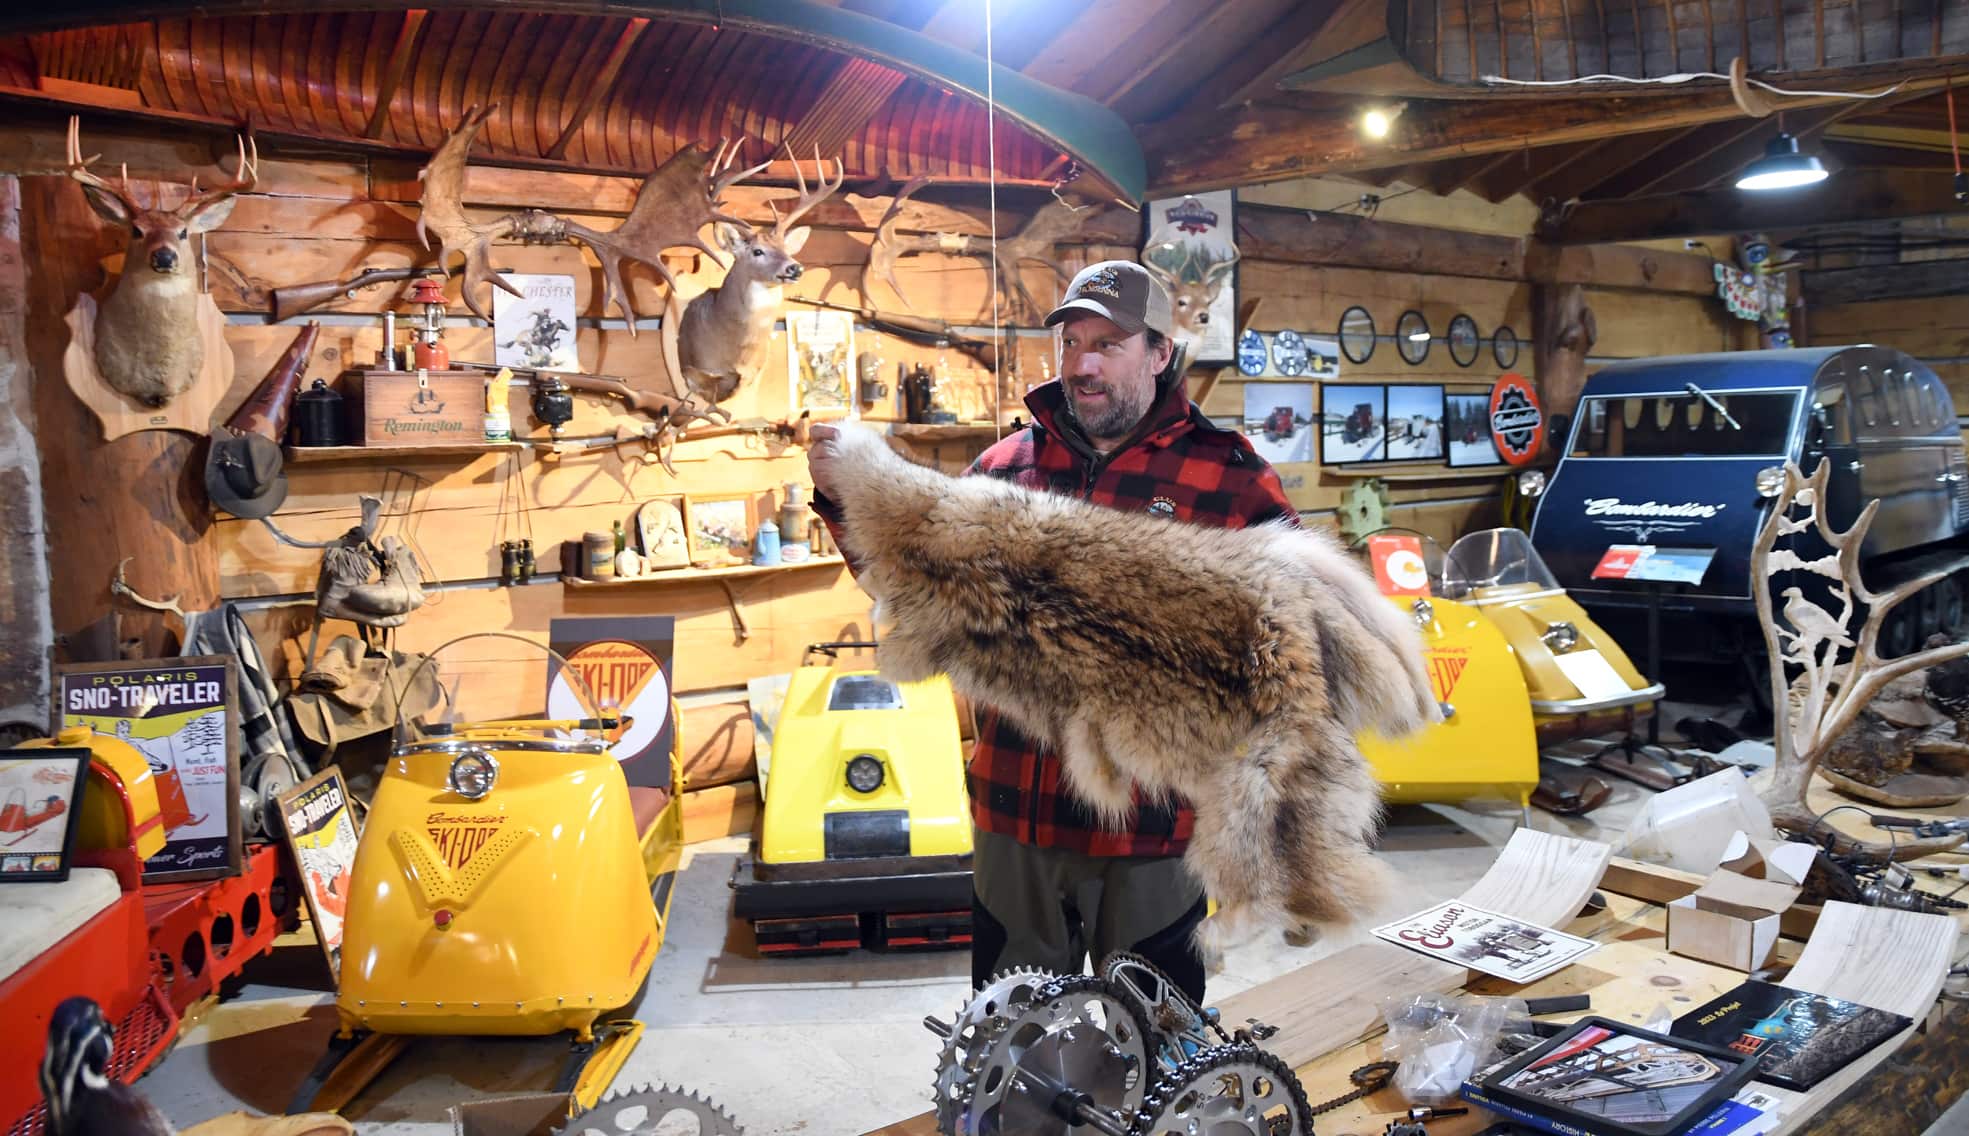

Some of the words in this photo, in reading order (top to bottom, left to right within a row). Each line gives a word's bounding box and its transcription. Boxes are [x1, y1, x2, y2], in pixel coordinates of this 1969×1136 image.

[496, 285, 573, 298] CHESTER
[384, 418, 463, 436] Remington
[1153, 496, 1176, 507] CLUB
[93, 672, 199, 686] POLARIS
[70, 682, 220, 710] SNO-TRAVELER
[292, 783, 330, 809] POLARIS
[176, 845, 224, 867] Sports
[1399, 908, 1465, 949] Eliason
[1551, 1121, 1580, 1136] HISTORY
